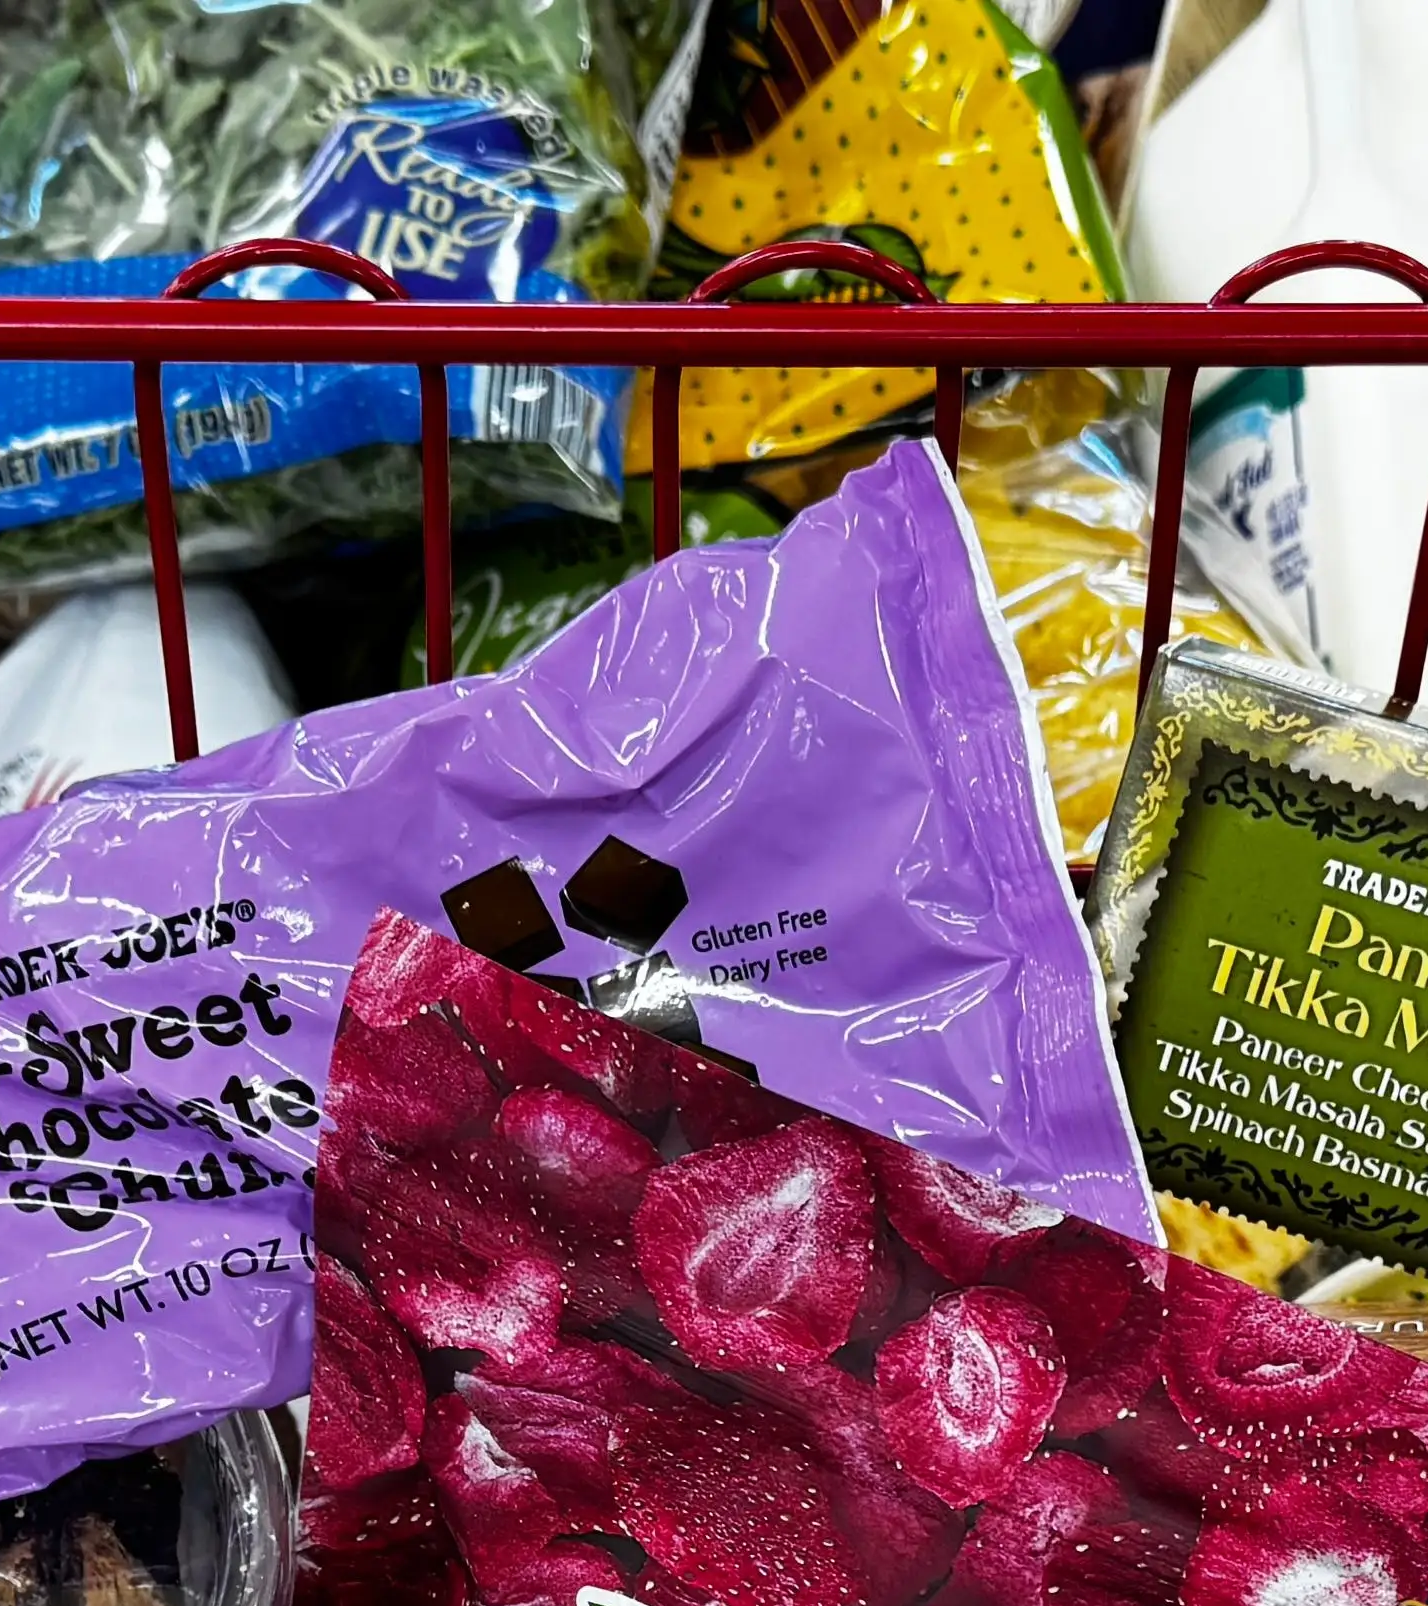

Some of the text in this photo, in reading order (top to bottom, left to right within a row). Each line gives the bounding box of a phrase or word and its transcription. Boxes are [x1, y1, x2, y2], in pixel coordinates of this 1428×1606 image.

[408, 186, 456, 224] TO
[357, 212, 466, 282] USE
[691, 908, 828, 953] Gluten Free
[709, 946, 828, 987] Dairy Free
[1208, 938, 1369, 1038] Tikka
[1212, 1016, 1343, 1082] Paneer
[1156, 1039, 1251, 1098] Tikka
[1259, 1074, 1386, 1140] Masala
[1163, 1088, 1305, 1159] Spinach
[77, 1278, 167, 1330] WT.
[165, 1260, 211, 1302] 10
[221, 1237, 291, 1278] OZ
